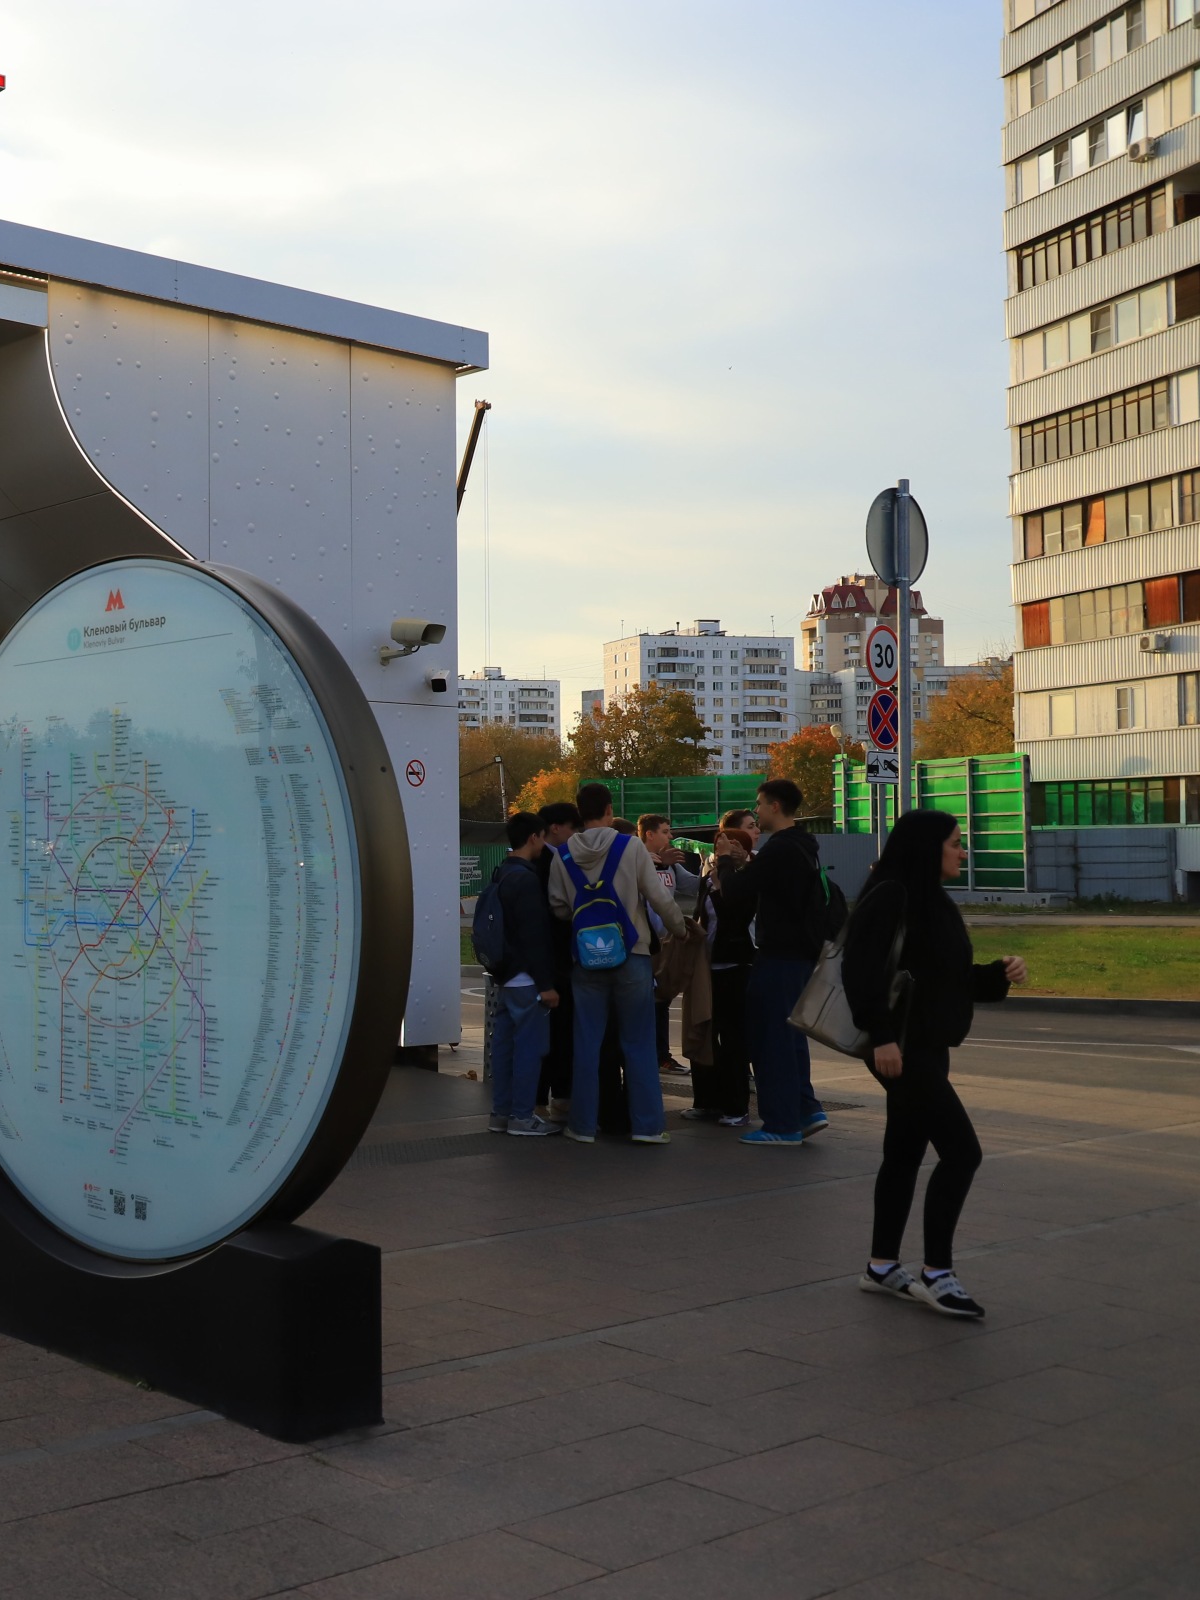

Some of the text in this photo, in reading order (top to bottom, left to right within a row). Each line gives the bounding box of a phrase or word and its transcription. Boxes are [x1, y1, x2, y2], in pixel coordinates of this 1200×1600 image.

[83, 616, 166, 638] Кленовый бульвар
[107, 636, 125, 646] Bulvar
[874, 643, 895, 669] 30
